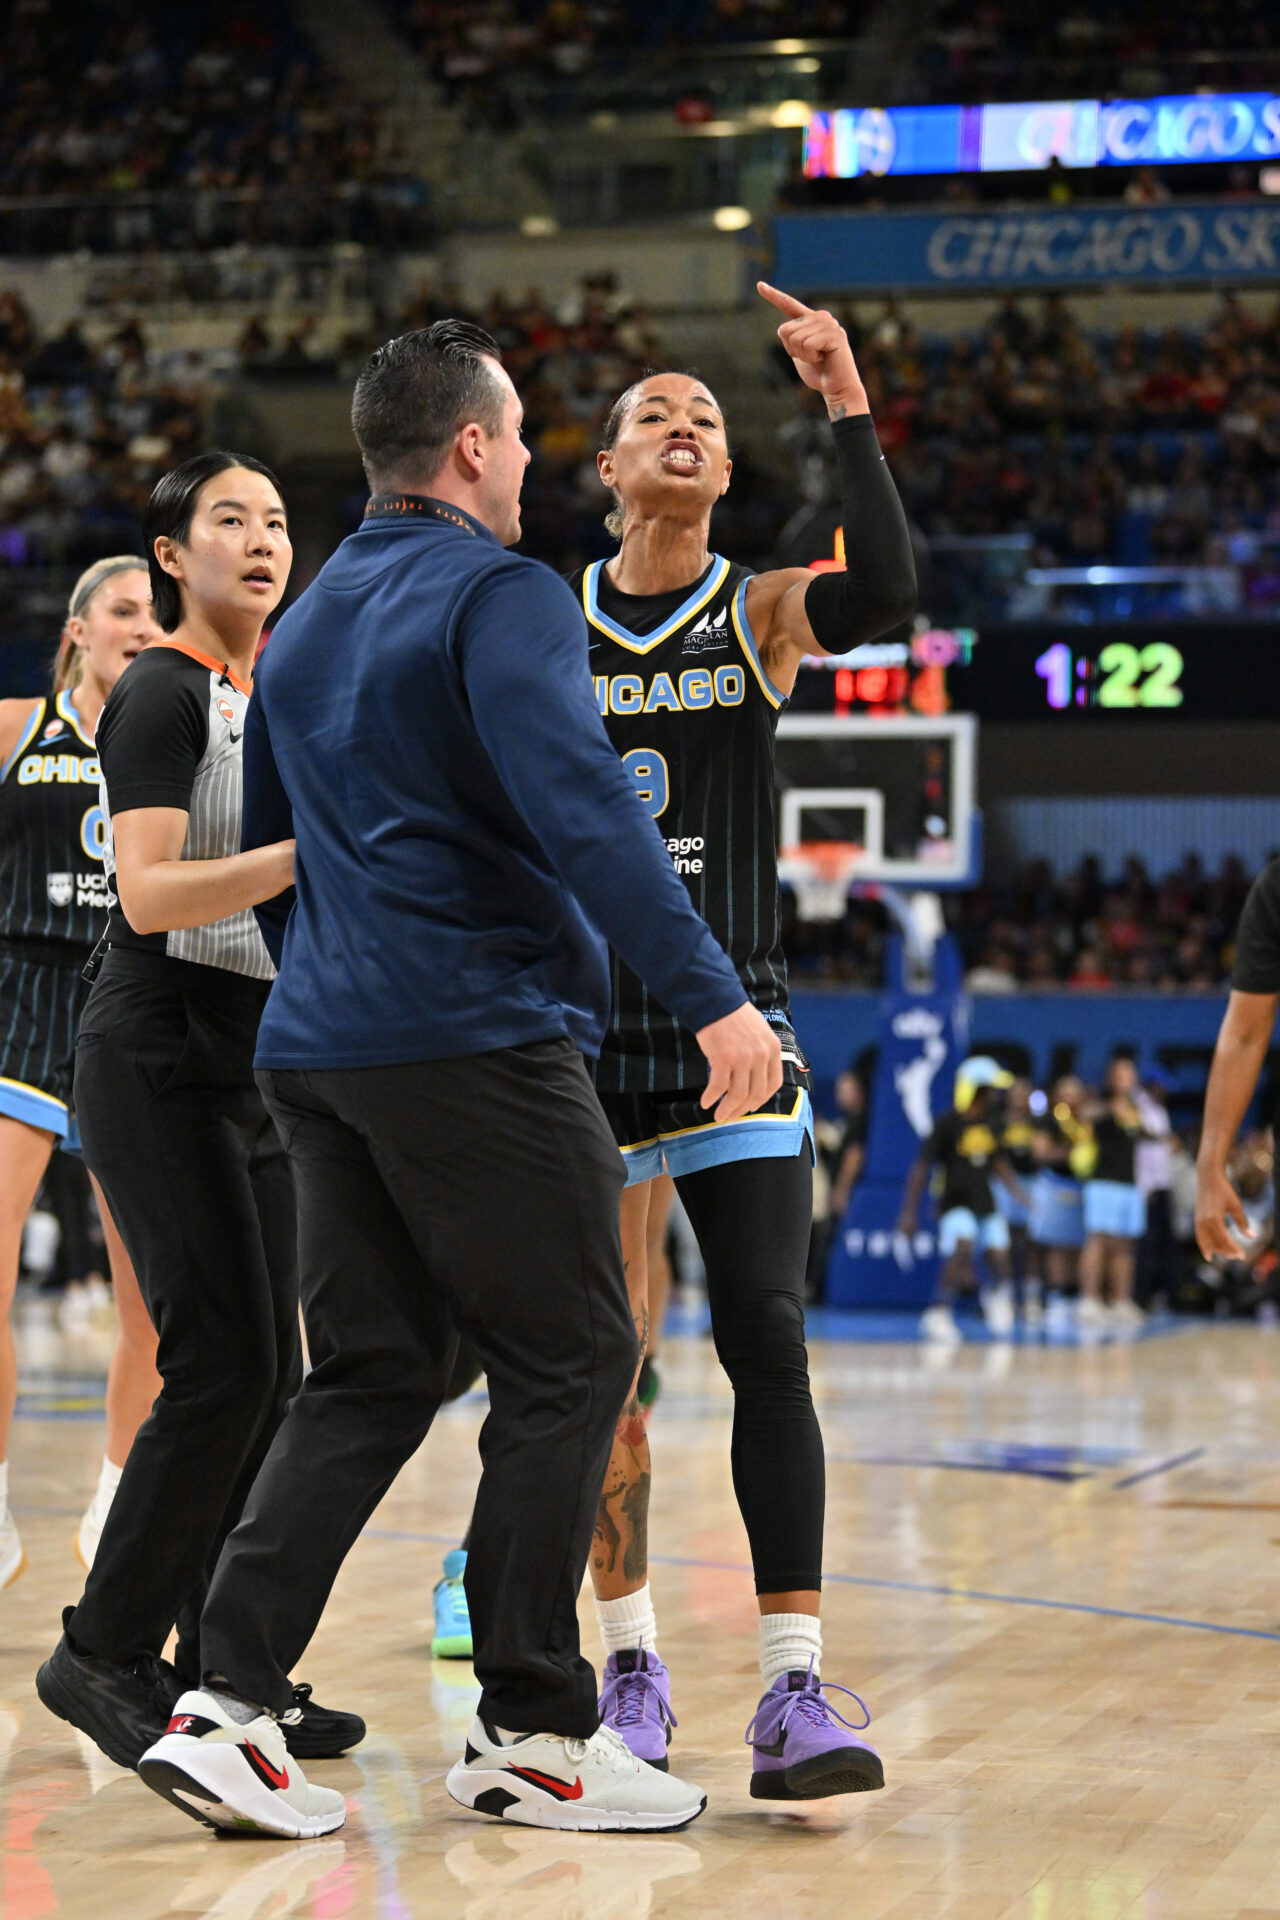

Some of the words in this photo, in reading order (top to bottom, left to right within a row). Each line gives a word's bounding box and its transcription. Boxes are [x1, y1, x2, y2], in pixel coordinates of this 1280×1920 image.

[927, 212, 1202, 279] CHICAGO
[592, 664, 746, 716] ICAGO
[1035, 642, 1184, 709] 1:22
[621, 748, 670, 819] 9
[662, 836, 704, 855] ago
